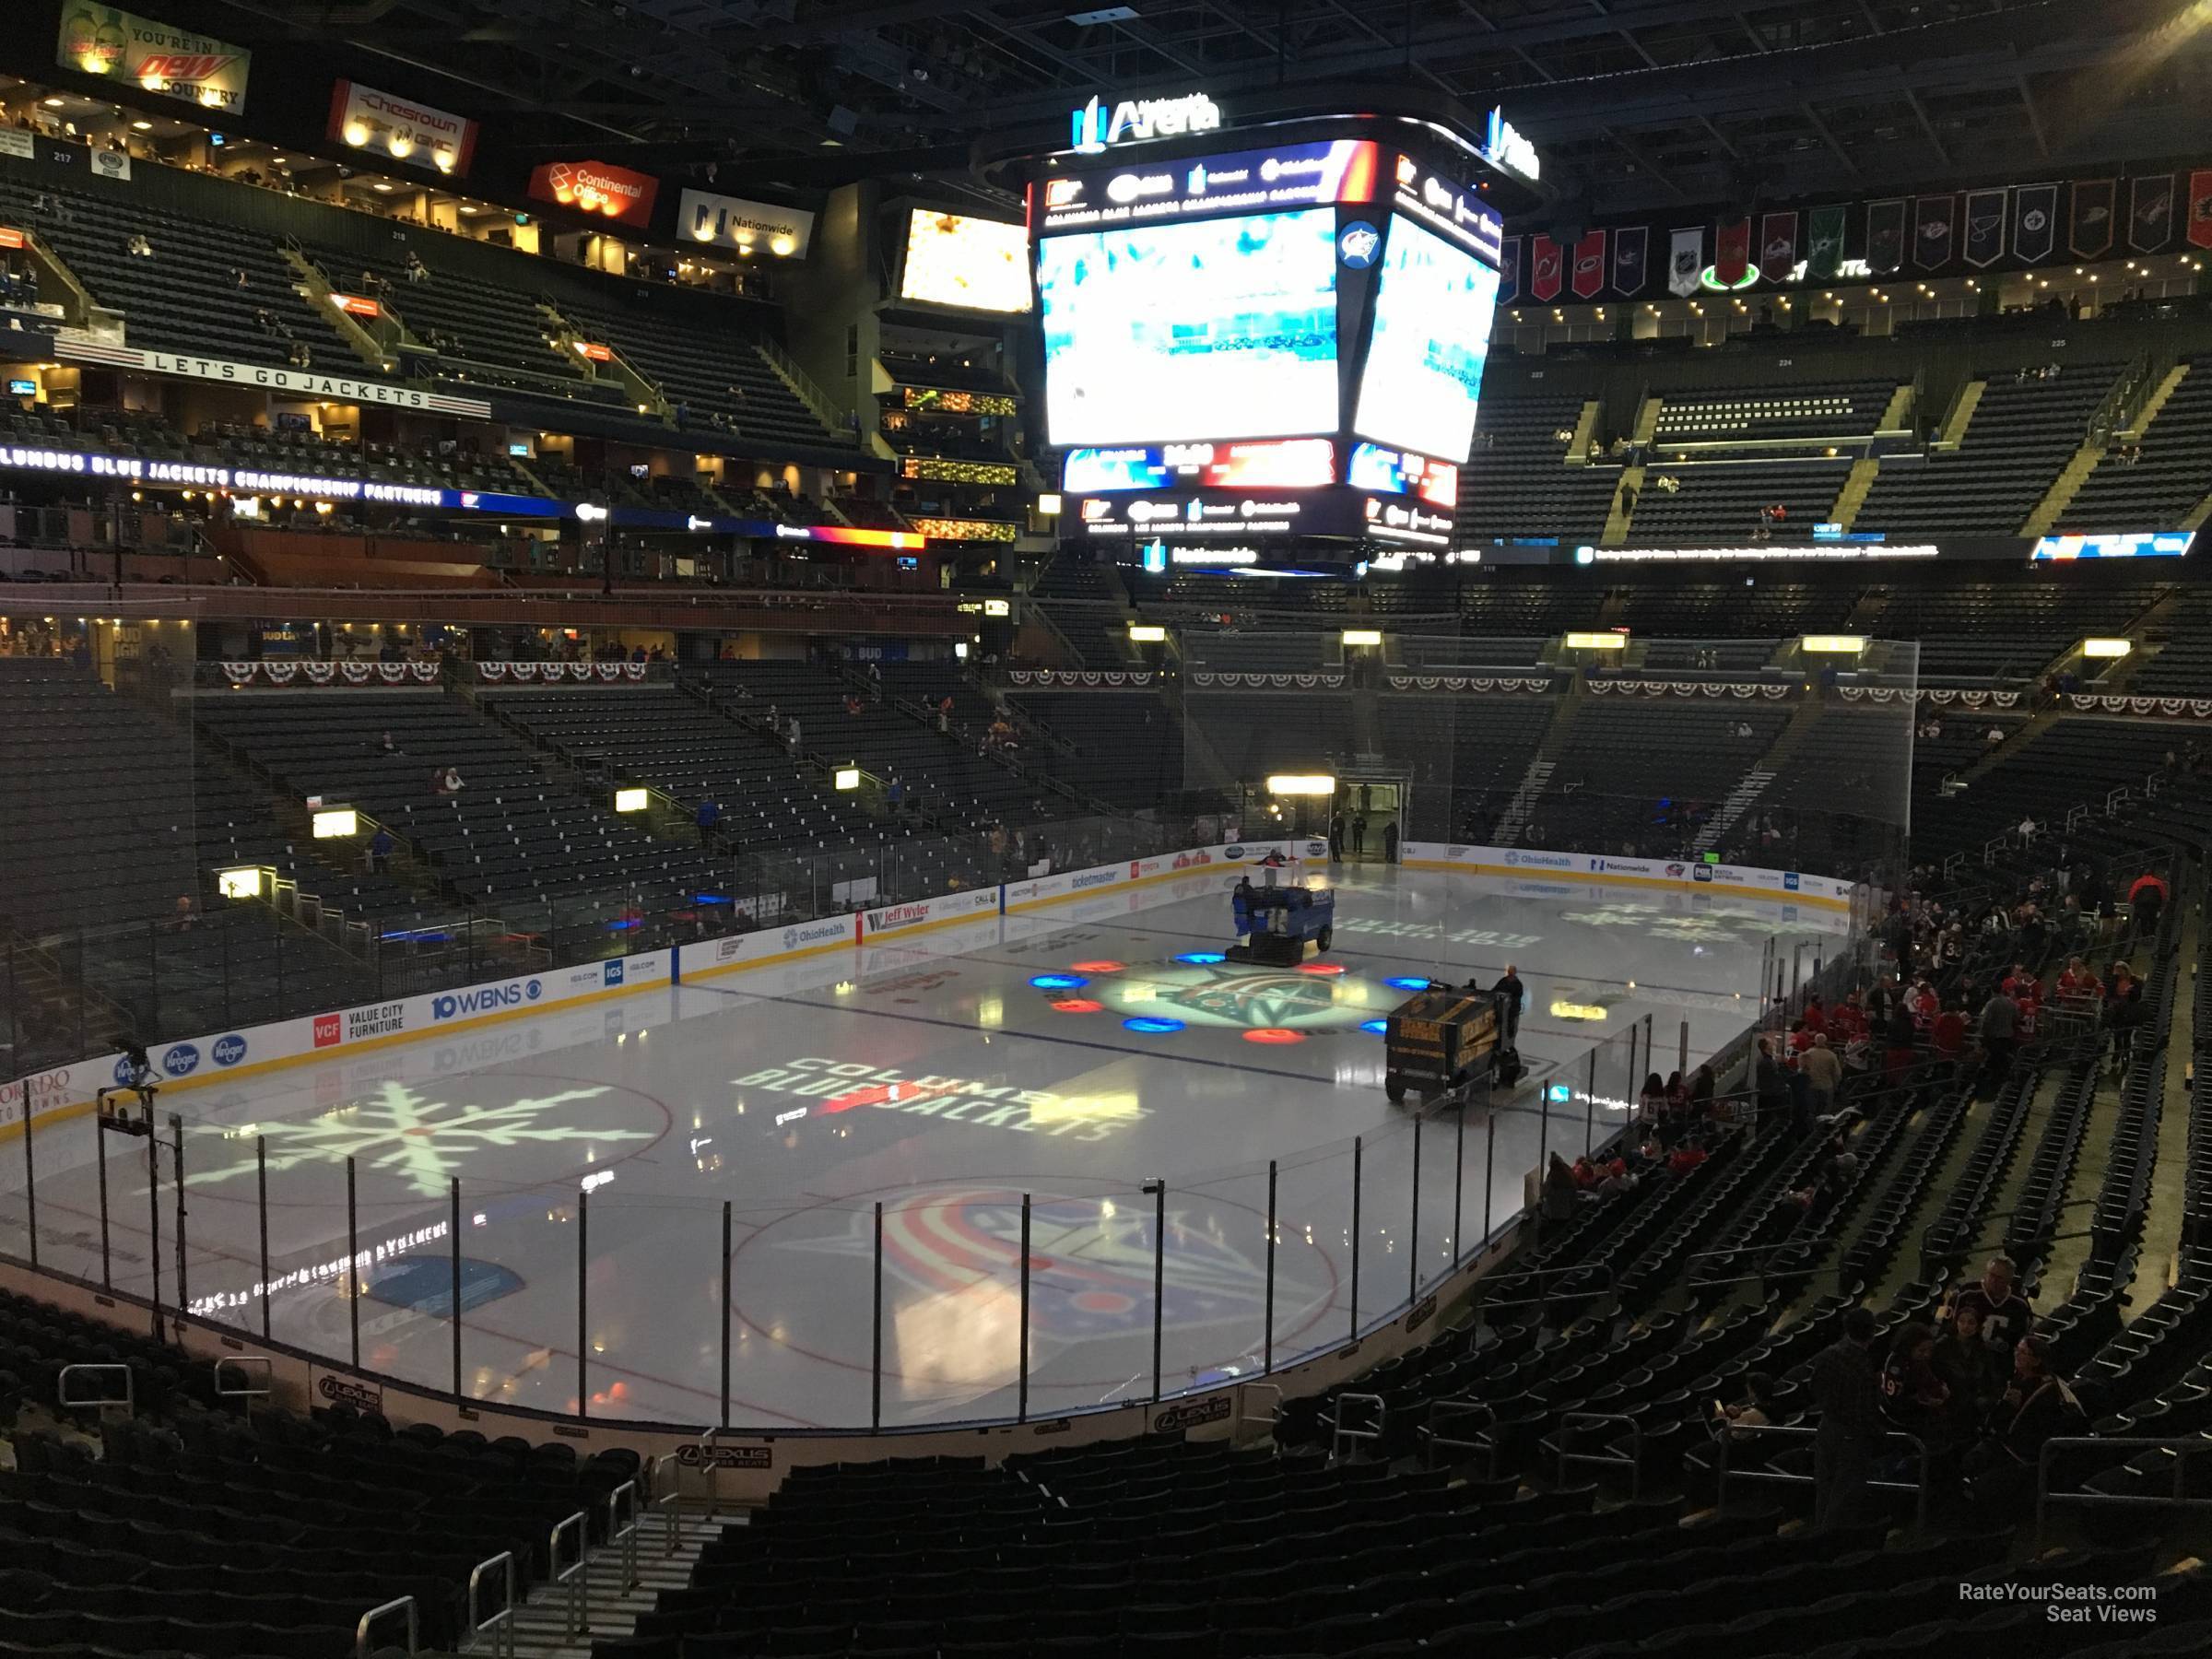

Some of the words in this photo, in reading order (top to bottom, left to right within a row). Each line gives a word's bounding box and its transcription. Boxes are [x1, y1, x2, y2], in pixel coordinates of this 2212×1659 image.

[132, 28, 192, 51] YOU'RE
[194, 41, 213, 54] IN
[162, 80, 239, 105] COUNTRY
[359, 93, 458, 135] Chesrown
[1107, 98, 1221, 142] Arena
[415, 133, 453, 153] GMC
[53, 151, 72, 163] 217
[572, 183, 609, 205] Office
[576, 169, 642, 199] Continental
[732, 215, 794, 236] Nationwide
[155, 354, 235, 379] LET'S
[255, 370, 288, 386] GO
[303, 377, 421, 406] JACKETS
[149, 462, 229, 486] JACKETS
[1606, 862, 1651, 874] Nationwide
[1072, 871, 1117, 888] ticketmaster
[902, 904, 930, 920] Wyler
[799, 924, 845, 941] OhioHealth
[606, 968, 622, 979] IGS
[348, 1009, 380, 1025] VALUE
[382, 1004, 404, 1018] CITY
[315, 1022, 340, 1040] VCF
[348, 1018, 404, 1039] FURNITURE
[166, 1051, 197, 1073] Kroger
[215, 1042, 244, 1064] Kroger
[335, 1382, 379, 1405] LEXUS
[702, 1447, 769, 1459] LEXUS
